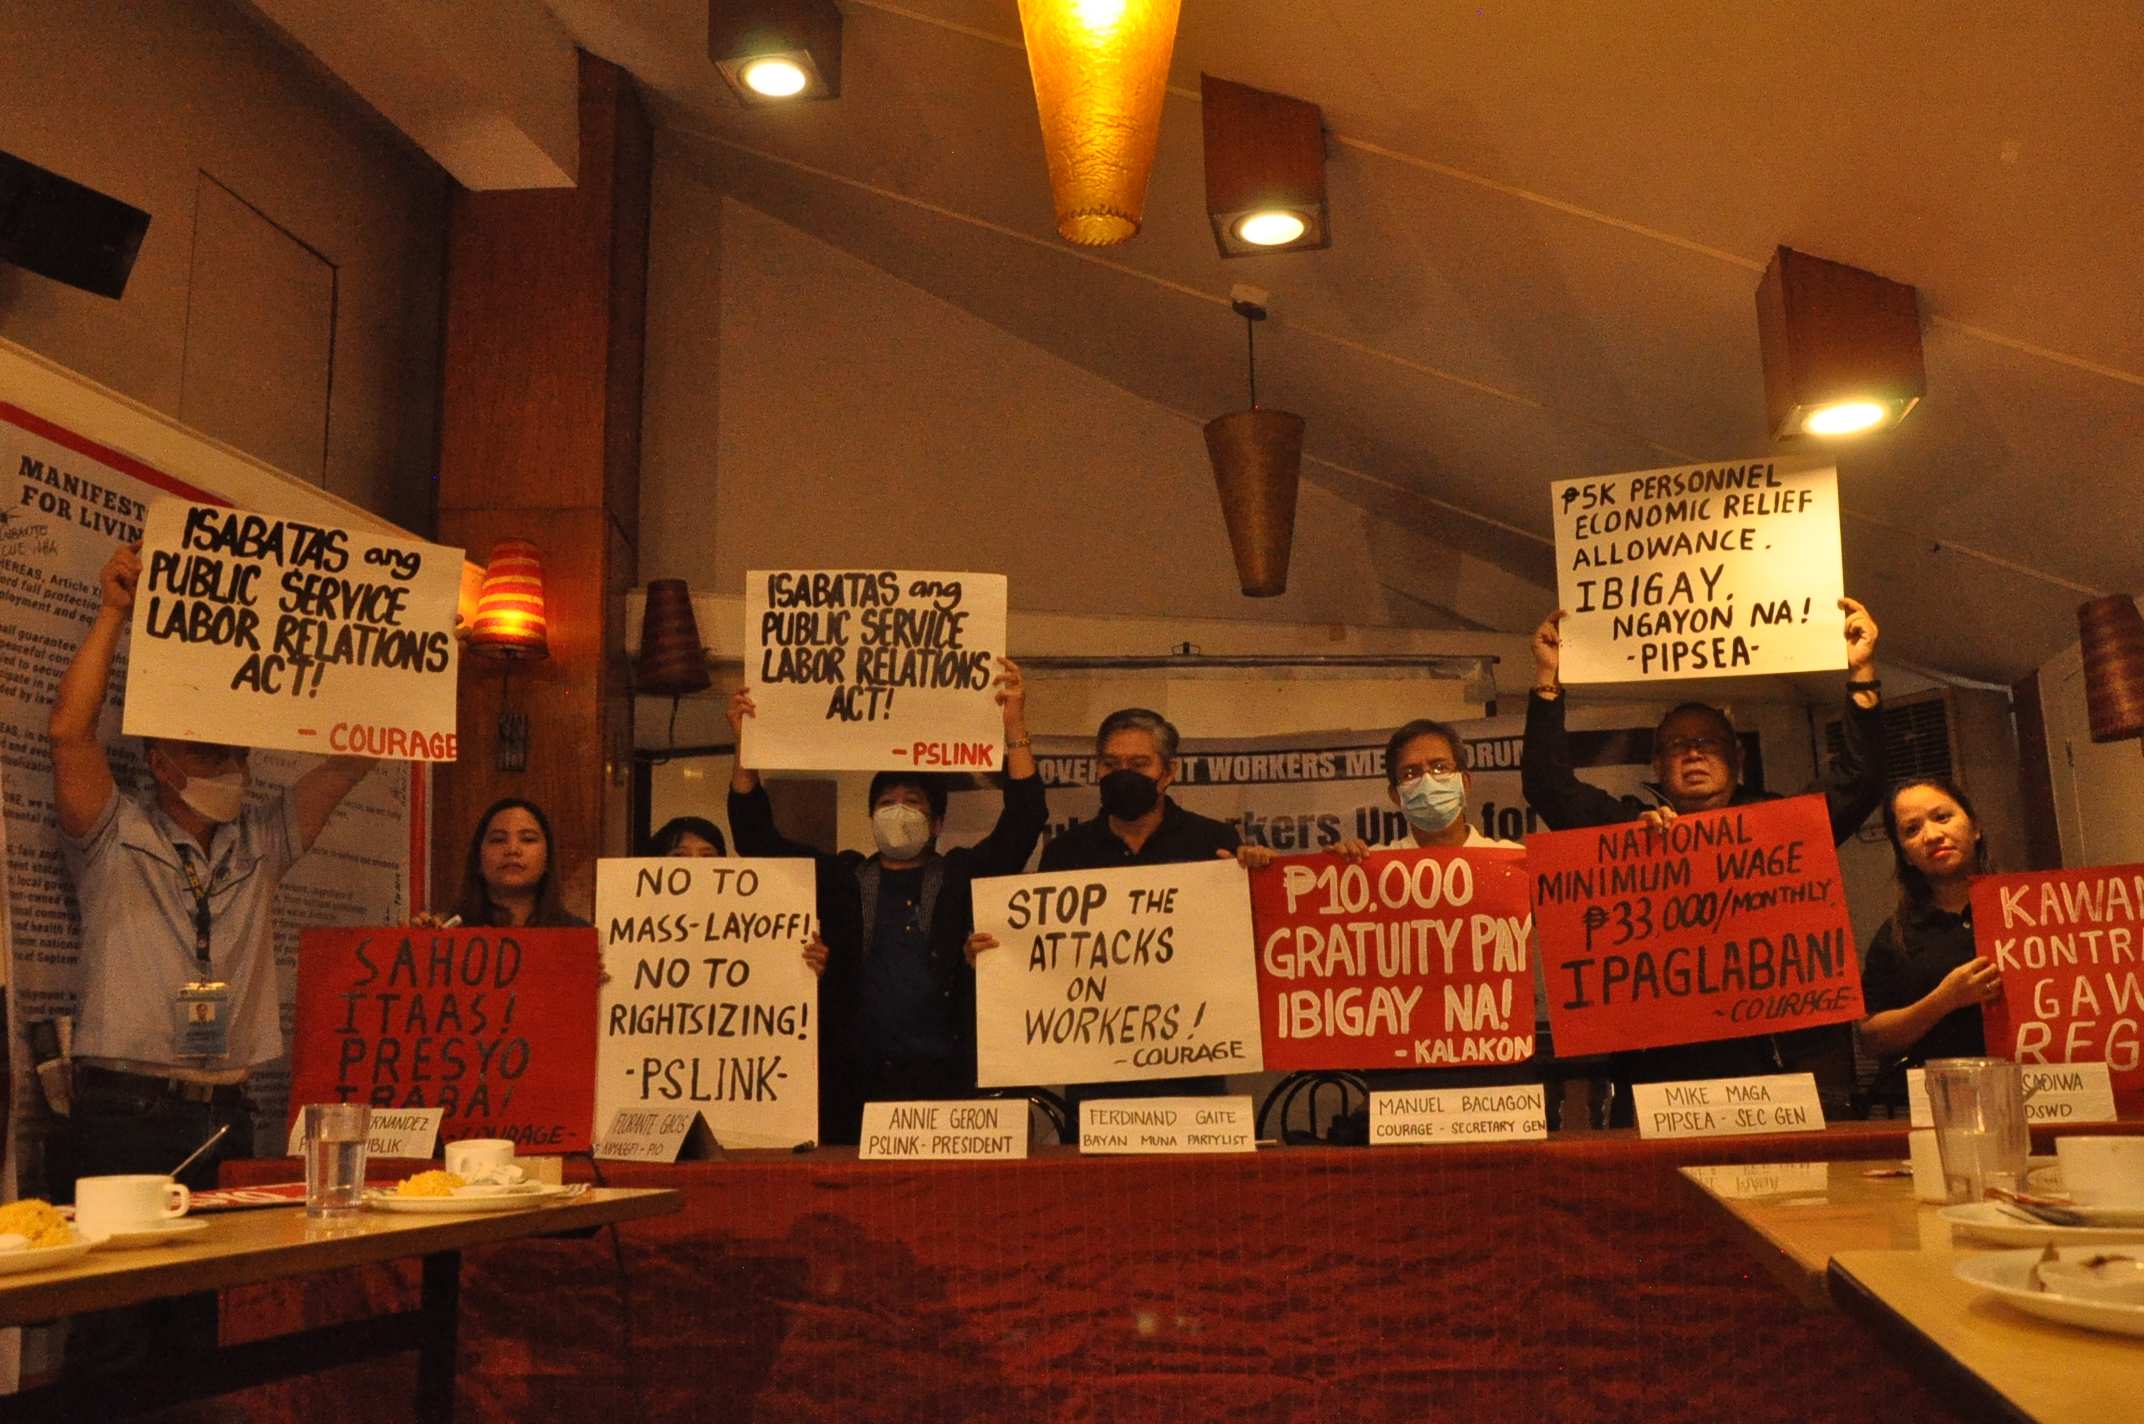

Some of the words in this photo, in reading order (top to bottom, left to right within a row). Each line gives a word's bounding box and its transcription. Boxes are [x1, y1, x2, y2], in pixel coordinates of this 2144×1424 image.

[20, 484, 72, 520] FOR
[1630, 464, 1782, 503] PERSONNEL
[1575, 498, 1711, 540] ECONOMIC
[1723, 490, 1812, 519] RELIEF
[182, 507, 349, 572] ISABATAS
[364, 548, 420, 580] ang
[50, 574, 89, 593] Article
[148, 550, 261, 606] PUBLIC
[279, 568, 410, 625] SERVICE
[768, 571, 900, 609] ISABATAS
[909, 580, 962, 612] ang
[18, 629, 77, 652] guarantee
[147, 596, 260, 652] LABOR
[273, 615, 449, 673] RELATIONS
[762, 610, 850, 647] PUBLIC
[861, 608, 969, 650] SERVICE
[1613, 604, 1733, 641] NGAYON
[231, 653, 325, 698] ACT!
[761, 647, 845, 684] LABOR
[856, 646, 991, 691] RELATIONS
[826, 685, 894, 722] ACT!
[1208, 751, 1336, 783] WORKERS
[636, 867, 691, 897] NO
[713, 868, 759, 896] TO
[1538, 857, 1691, 906] MINIMUM
[1716, 841, 1804, 883] WAGE
[1007, 883, 1107, 929] STOP
[1129, 888, 1179, 915] THE
[609, 912, 810, 945] MASS-LAYOFF!
[1263, 918, 1463, 980] GRATUITY
[1471, 913, 1532, 973] PAY
[354, 936, 522, 988] SAHOD
[1029, 926, 1174, 972] ATTACKS
[634, 957, 690, 989] NO
[703, 958, 749, 989] TO
[1561, 927, 1844, 1011] IPAGLABAN!
[1067, 976, 1107, 1002] ON
[1278, 985, 1423, 1038] IBIGAY
[1444, 978, 1513, 1032] NA!
[334, 991, 517, 1035] ITAAS!
[609, 1002, 808, 1040] RIGHTSIZING!
[339, 1036, 531, 1084] PRESYO
[1379, 1097, 1445, 1116] MANUEL
[1462, 1093, 1542, 1113] BACLAGON
[1665, 1087, 1710, 1107] MIKE
[1726, 1085, 1771, 1103] MAGA
[889, 1107, 939, 1130] ANNIE
[950, 1108, 998, 1130] GERON
[1089, 1109, 1178, 1126] FERDINAND
[1195, 1110, 1237, 1125] GAITE
[1376, 1123, 1433, 1137] COURAGE
[1451, 1120, 1515, 1134] SECRETARY
[1522, 1120, 1546, 1133] GEN
[1653, 1111, 1716, 1133] PIPSEA
[1734, 1108, 1767, 1128] SEC
[1774, 1105, 1807, 1125] GEN
[1083, 1135, 1128, 1147] BAYAN
[1141, 1135, 1177, 1147] MUNA
[1187, 1134, 1249, 1146] PARTYLIST
